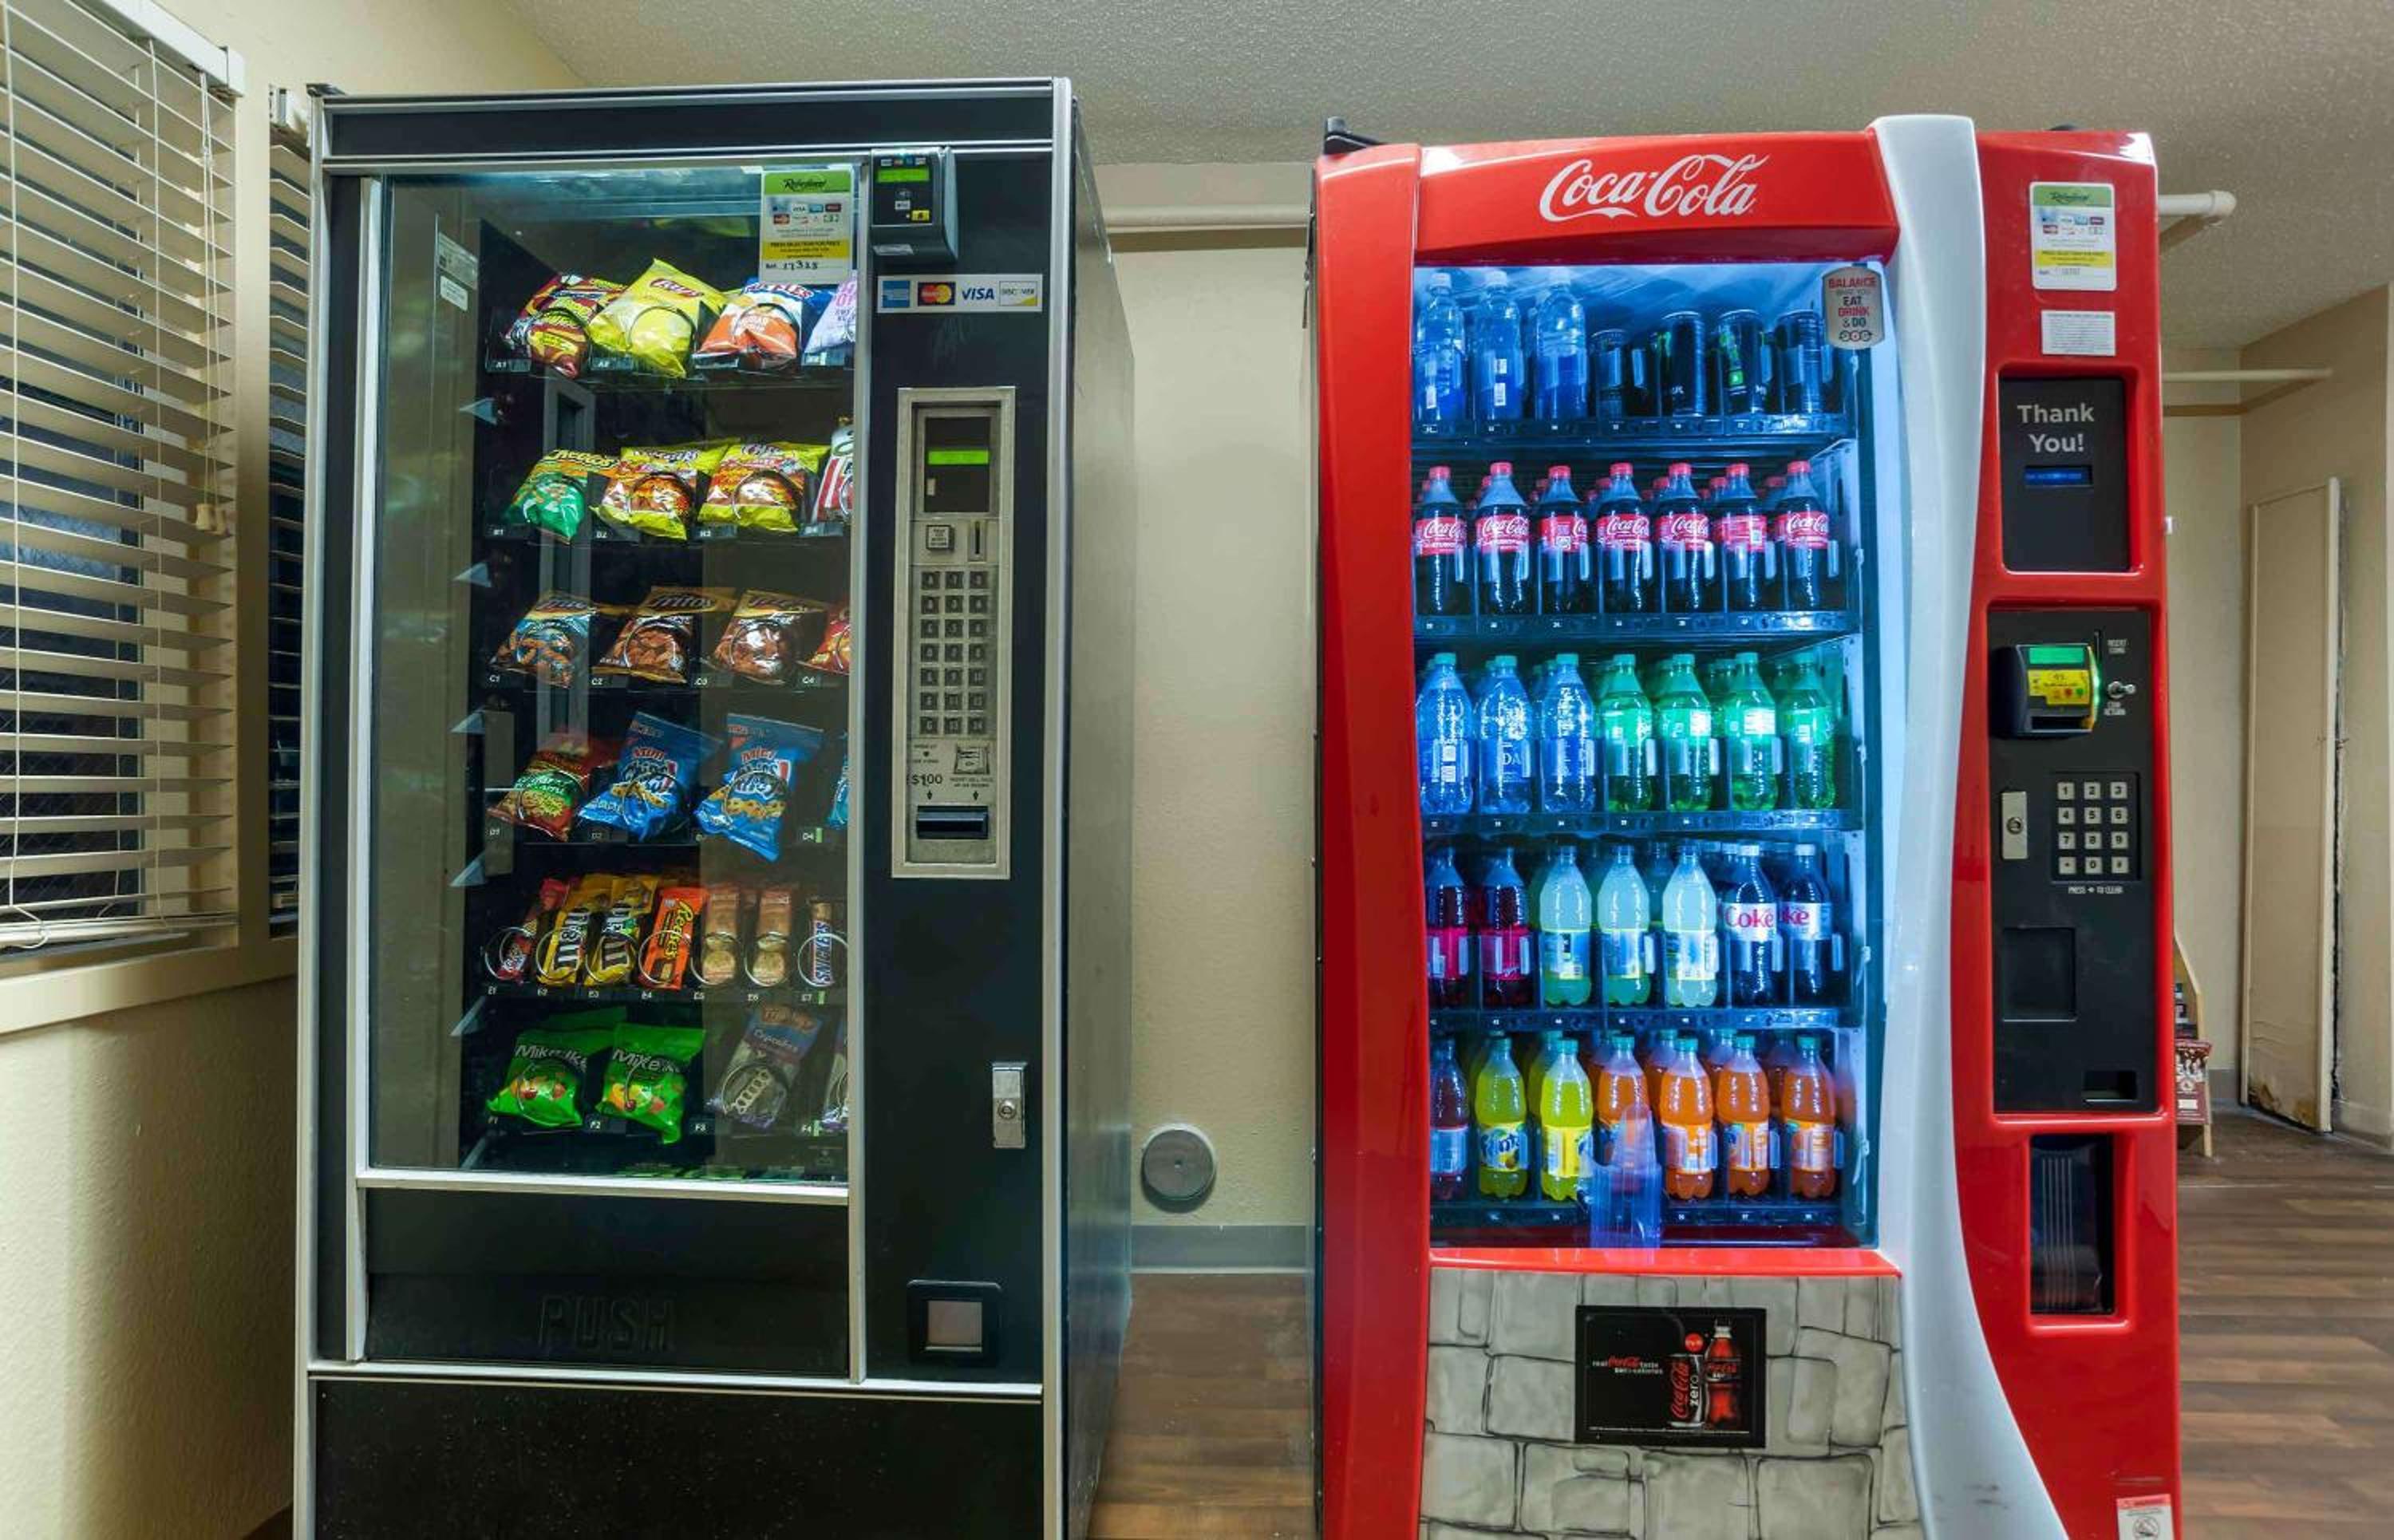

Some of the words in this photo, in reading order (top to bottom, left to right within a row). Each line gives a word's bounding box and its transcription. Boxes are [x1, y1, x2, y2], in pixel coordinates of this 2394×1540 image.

[1539, 154, 1771, 222] Coca-Cola
[1828, 277, 1877, 288] BALANCE
[962, 287, 995, 300] VISA
[1843, 296, 1862, 305] EAT
[2017, 402, 2095, 423] Thank
[2029, 433, 2084, 452] You!
[1671, 516, 1709, 535] Coca-Co
[1787, 515, 1829, 535] Coca-Co
[2089, 835, 2096, 844] 8
[2089, 860, 2096, 869] 0
[1724, 906, 1774, 928] Coke
[1780, 906, 1810, 926] ke
[612, 1048, 661, 1072] Mike
[538, 1293, 677, 1354] PUSH
[1689, 1375, 1699, 1407] zero
